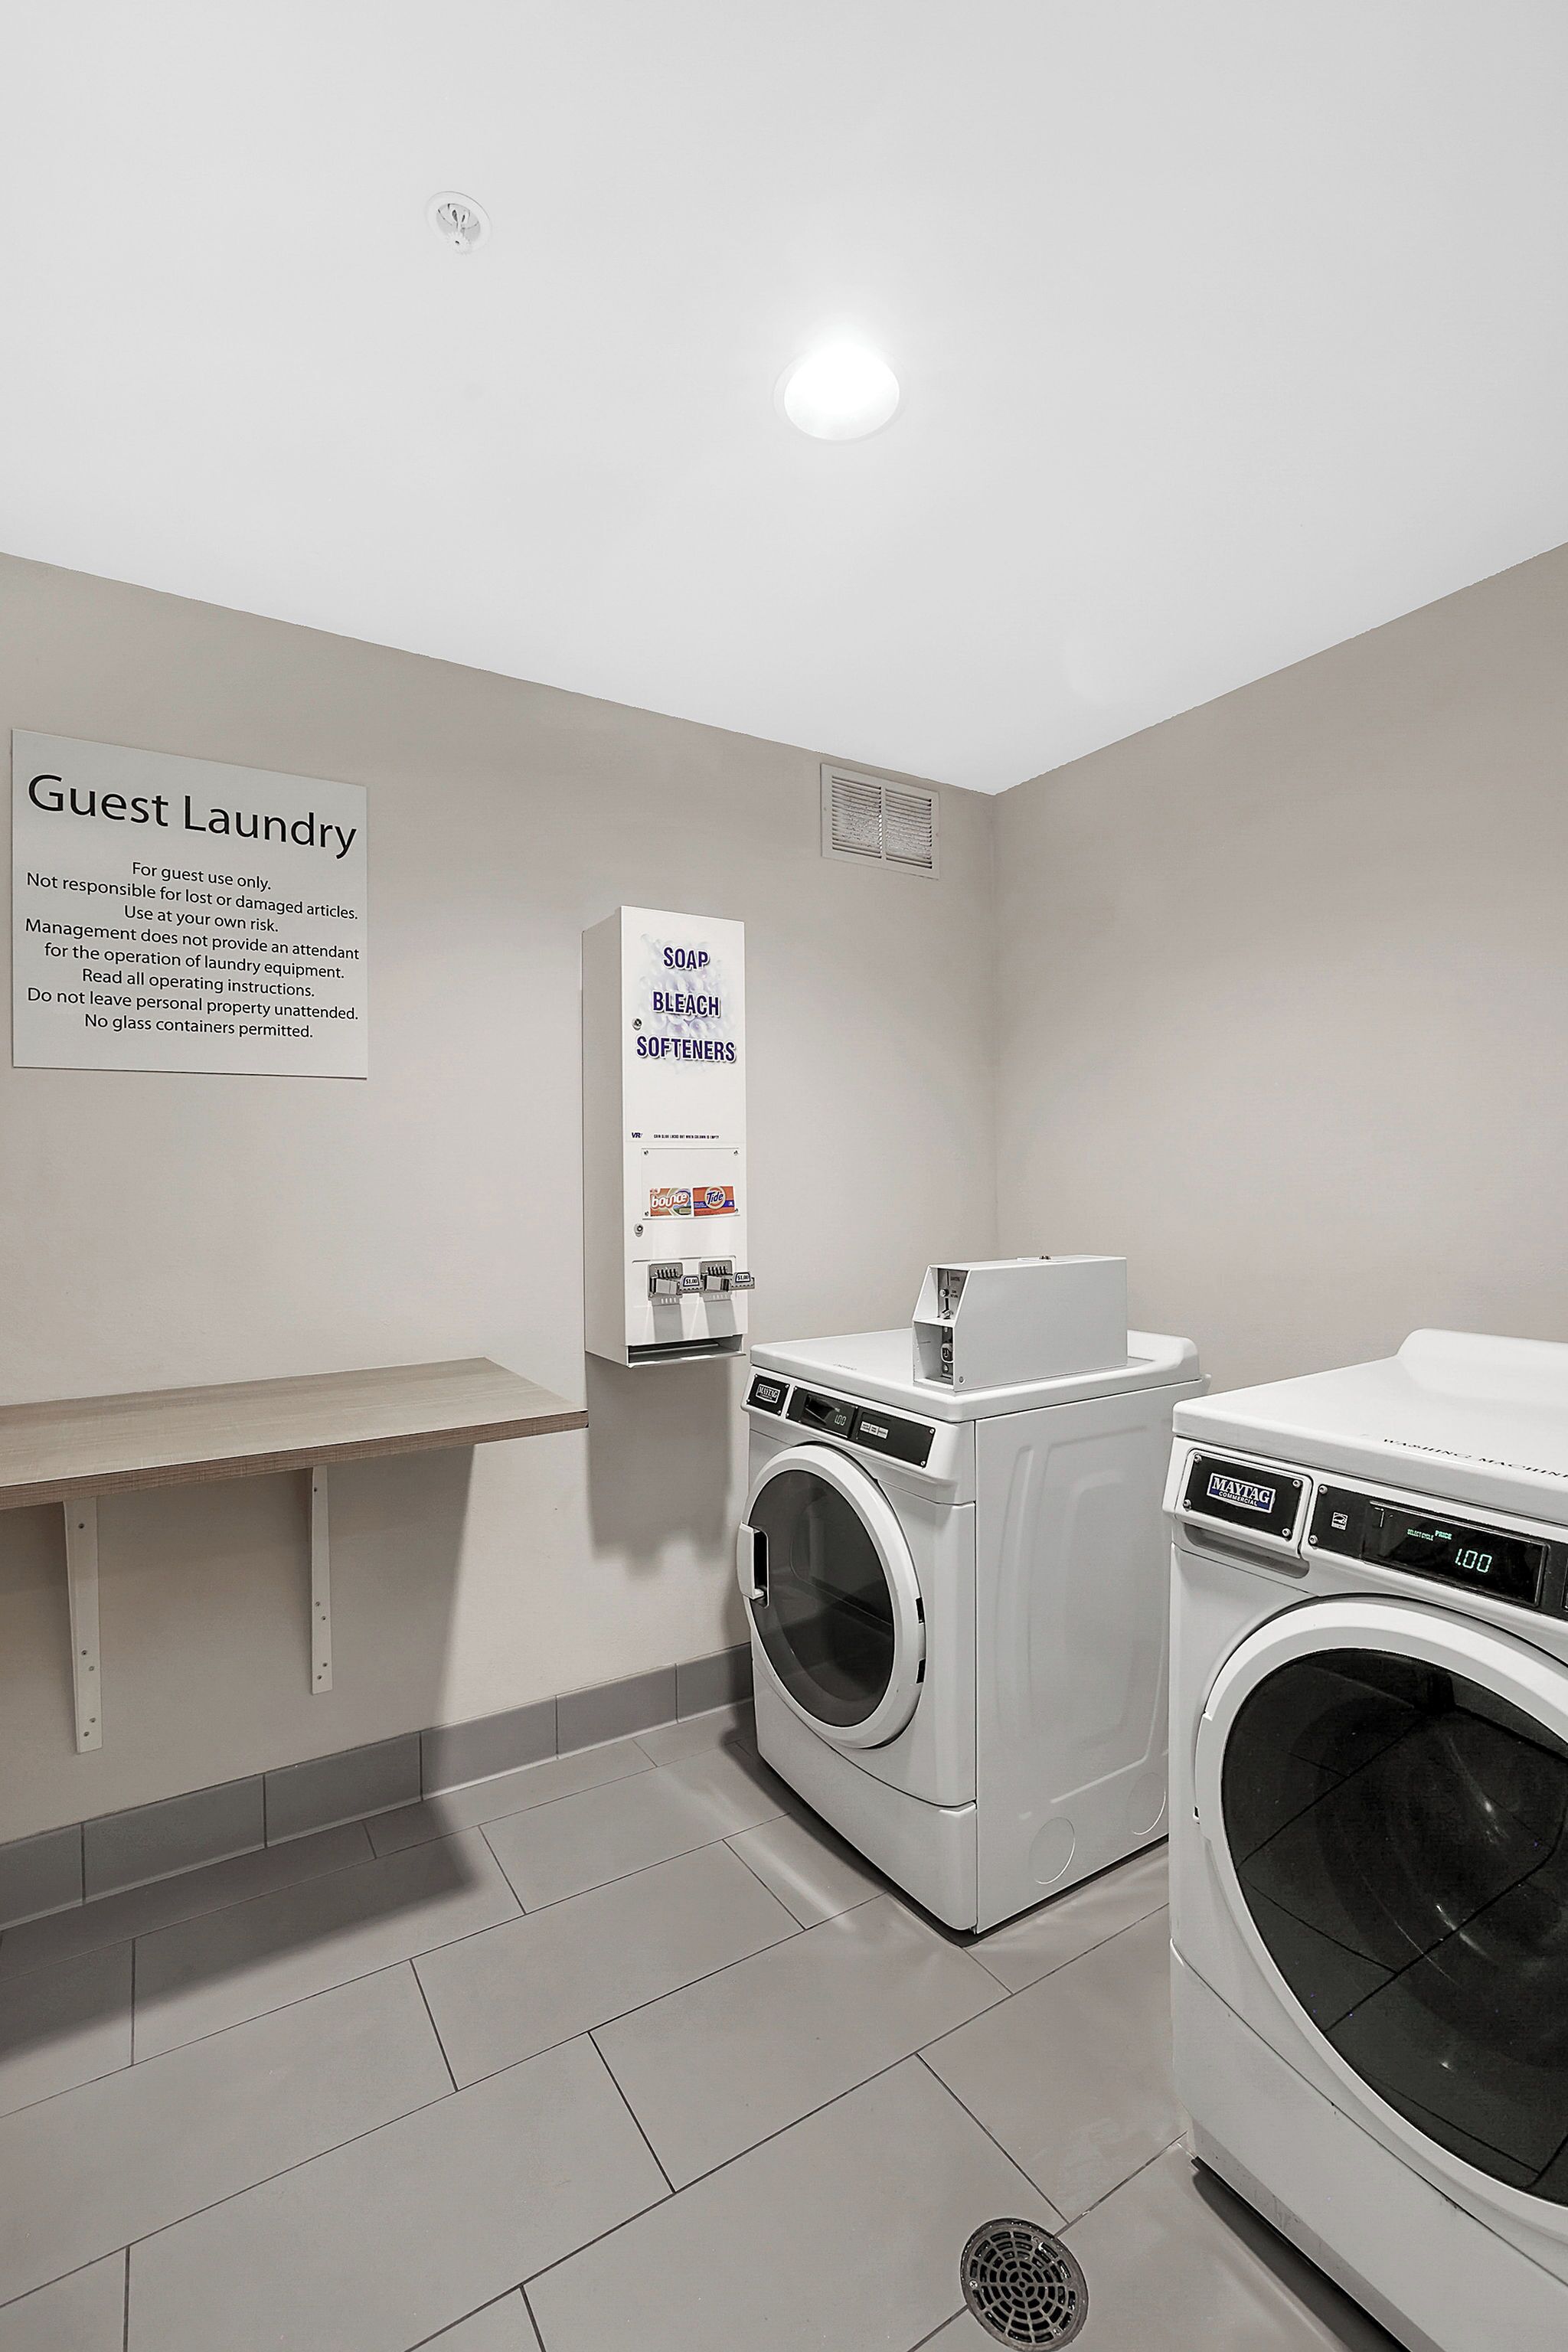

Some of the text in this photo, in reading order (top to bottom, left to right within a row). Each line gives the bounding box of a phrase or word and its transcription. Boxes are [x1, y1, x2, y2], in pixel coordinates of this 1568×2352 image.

[28, 774, 358, 860] Guest Laundry
[132, 861, 271, 893] For guest use only.
[27, 871, 358, 920] Not responsible for lost or damaged articles.
[124, 904, 279, 933] Use at your own risk.
[25, 918, 360, 960] Management does not provide an attendant
[44, 942, 345, 979] for the operation of laundry equipment.
[663, 946, 709, 969] SOAP
[83, 968, 315, 998] Read all operating instructions.
[28, 987, 358, 1020] Do not leave personal property unattended.
[653, 991, 720, 1016] BLEACH
[85, 1013, 313, 1038] No glass containers permitted.
[636, 1035, 736, 1062] SOFTENERS
[707, 1191, 724, 1204] Tide
[1383, 1439, 1472, 1459] WASHING
[1211, 1477, 1270, 1504] MAYTAG
[1219, 1491, 1258, 1507] COMMERCIAL
[1407, 1528, 1434, 1541] SELECT CYCLE
[1435, 1530, 1452, 1540] PRICE
[1455, 1548, 1492, 1573] 1.00
